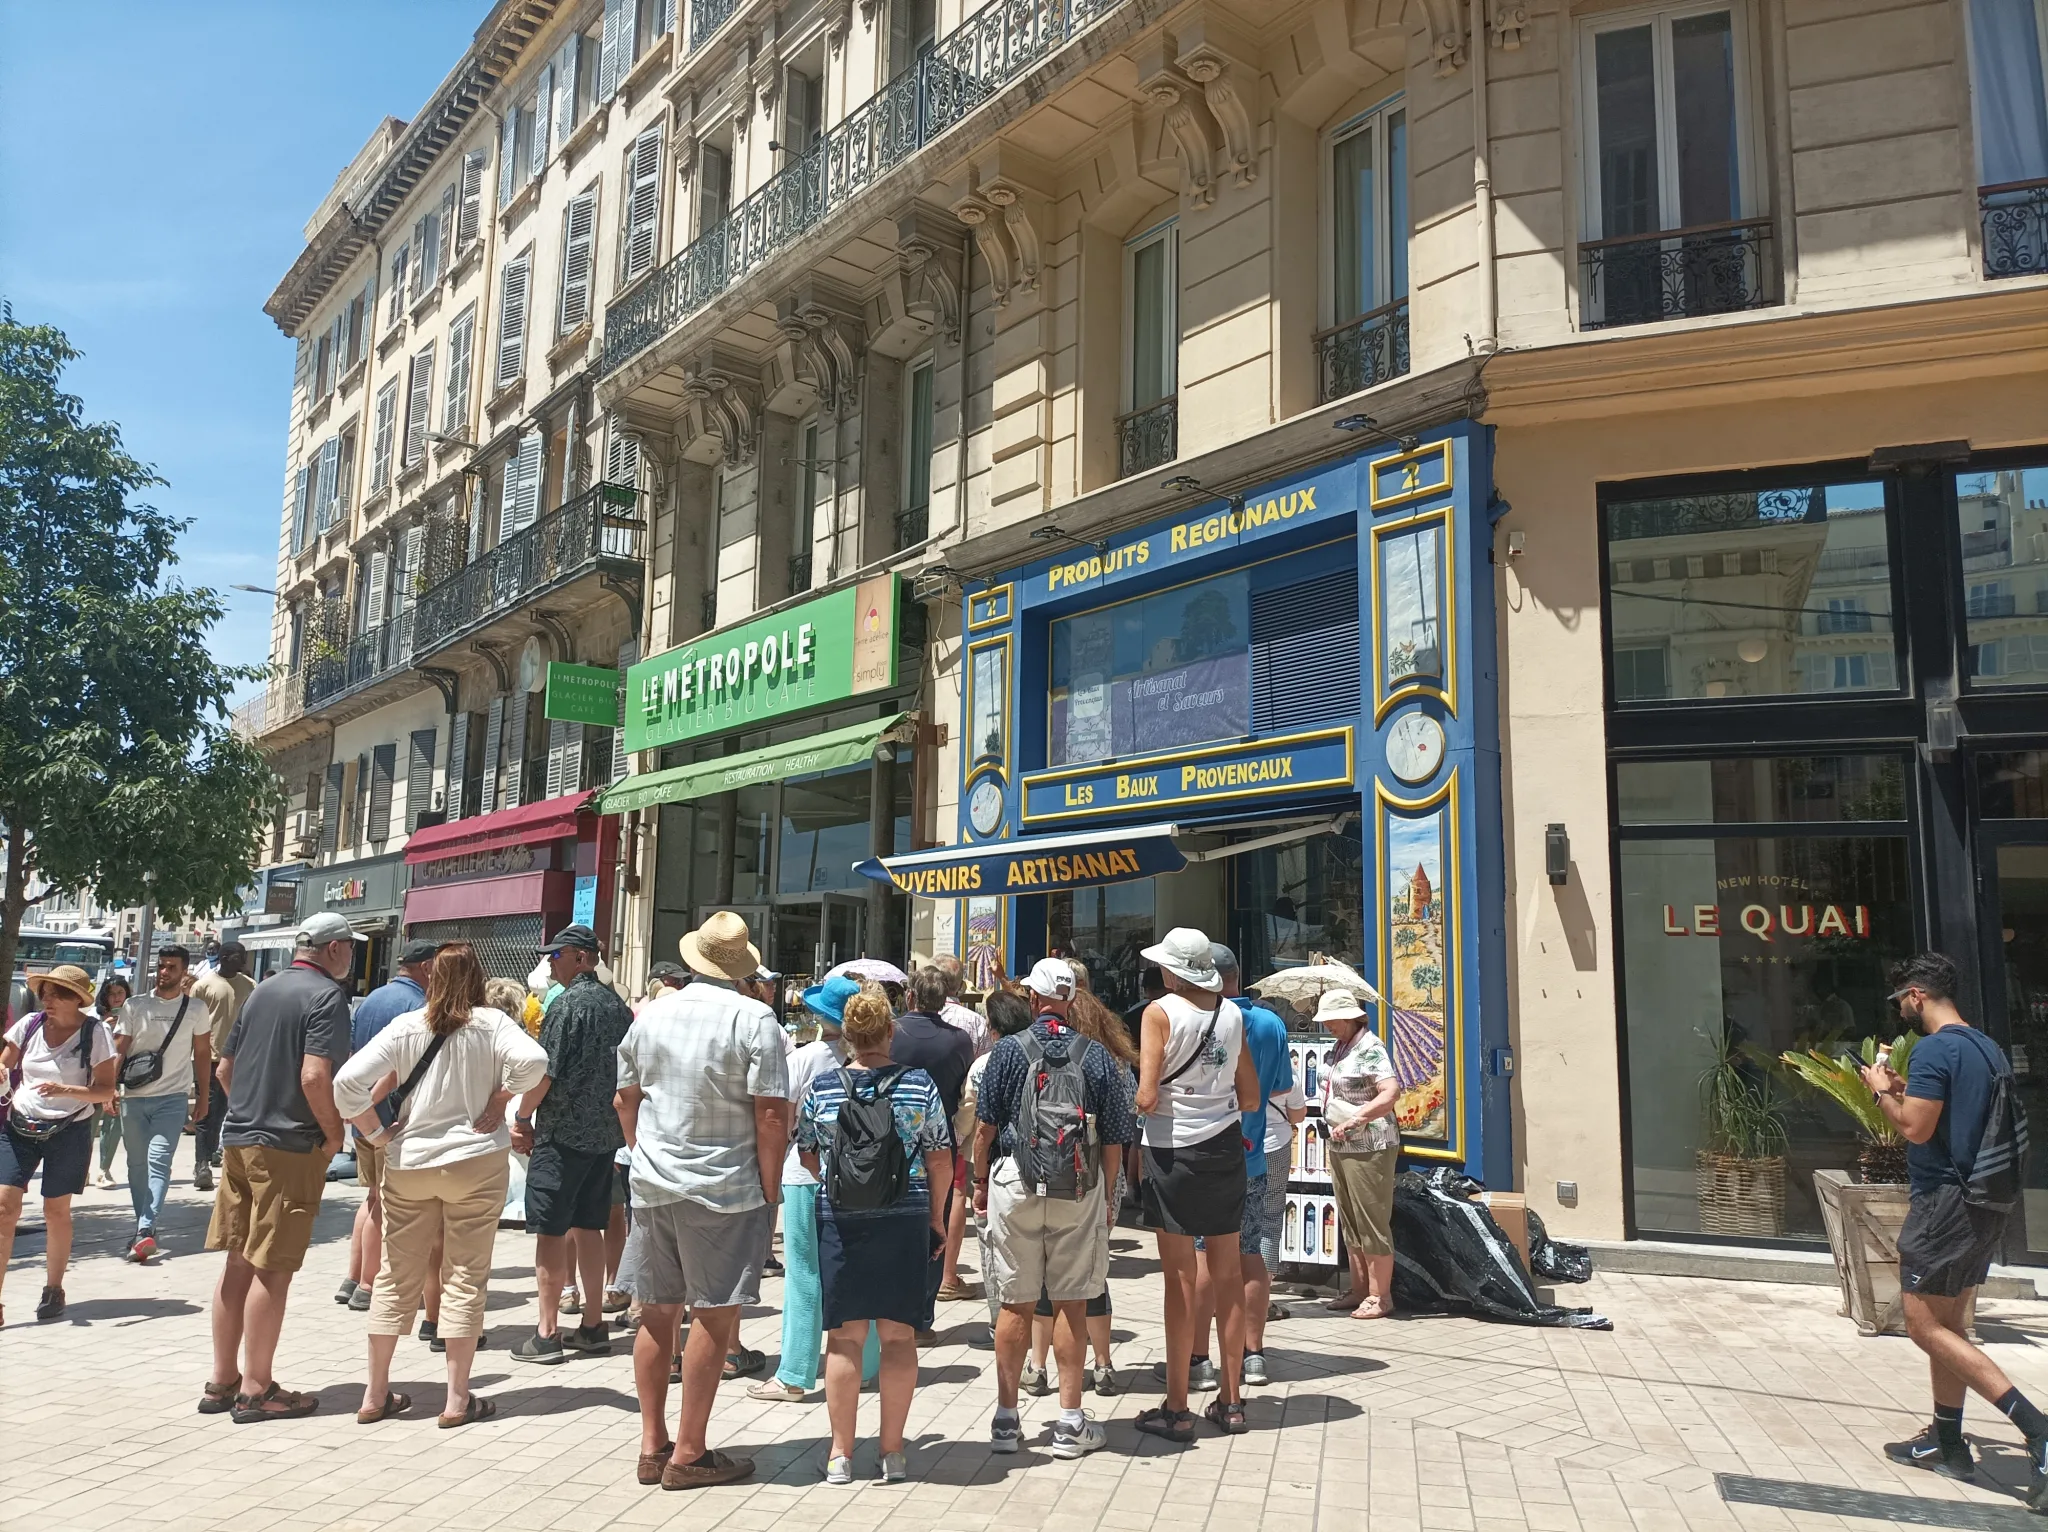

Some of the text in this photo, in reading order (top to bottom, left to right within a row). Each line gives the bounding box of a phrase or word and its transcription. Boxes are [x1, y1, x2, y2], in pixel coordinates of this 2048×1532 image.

[1401, 461, 1420, 490] 2
[1047, 486, 1317, 592] PRODUITS REGIONAUX
[985, 597, 997, 617] 2
[641, 622, 813, 706] LE MÉTROPOLE
[856, 661, 885, 683] simply
[1127, 670, 1188, 702] Artisanat
[1157, 687, 1225, 713] et Saveurs
[645, 706, 715, 742] GLACIER
[724, 691, 756, 721] BIO
[605, 797, 631, 809] GLACIER
[638, 791, 648, 804] BIO
[723, 763, 776, 786] RESTAURATION
[784, 754, 821, 772] HEALTHY
[1064, 756, 1293, 807] LES BAUX PROVENCAUX
[1006, 848, 1141, 888] ARTISANAT
[1717, 874, 1809, 891] NEW HOTEL
[1663, 904, 1870, 943] LE QUAI
